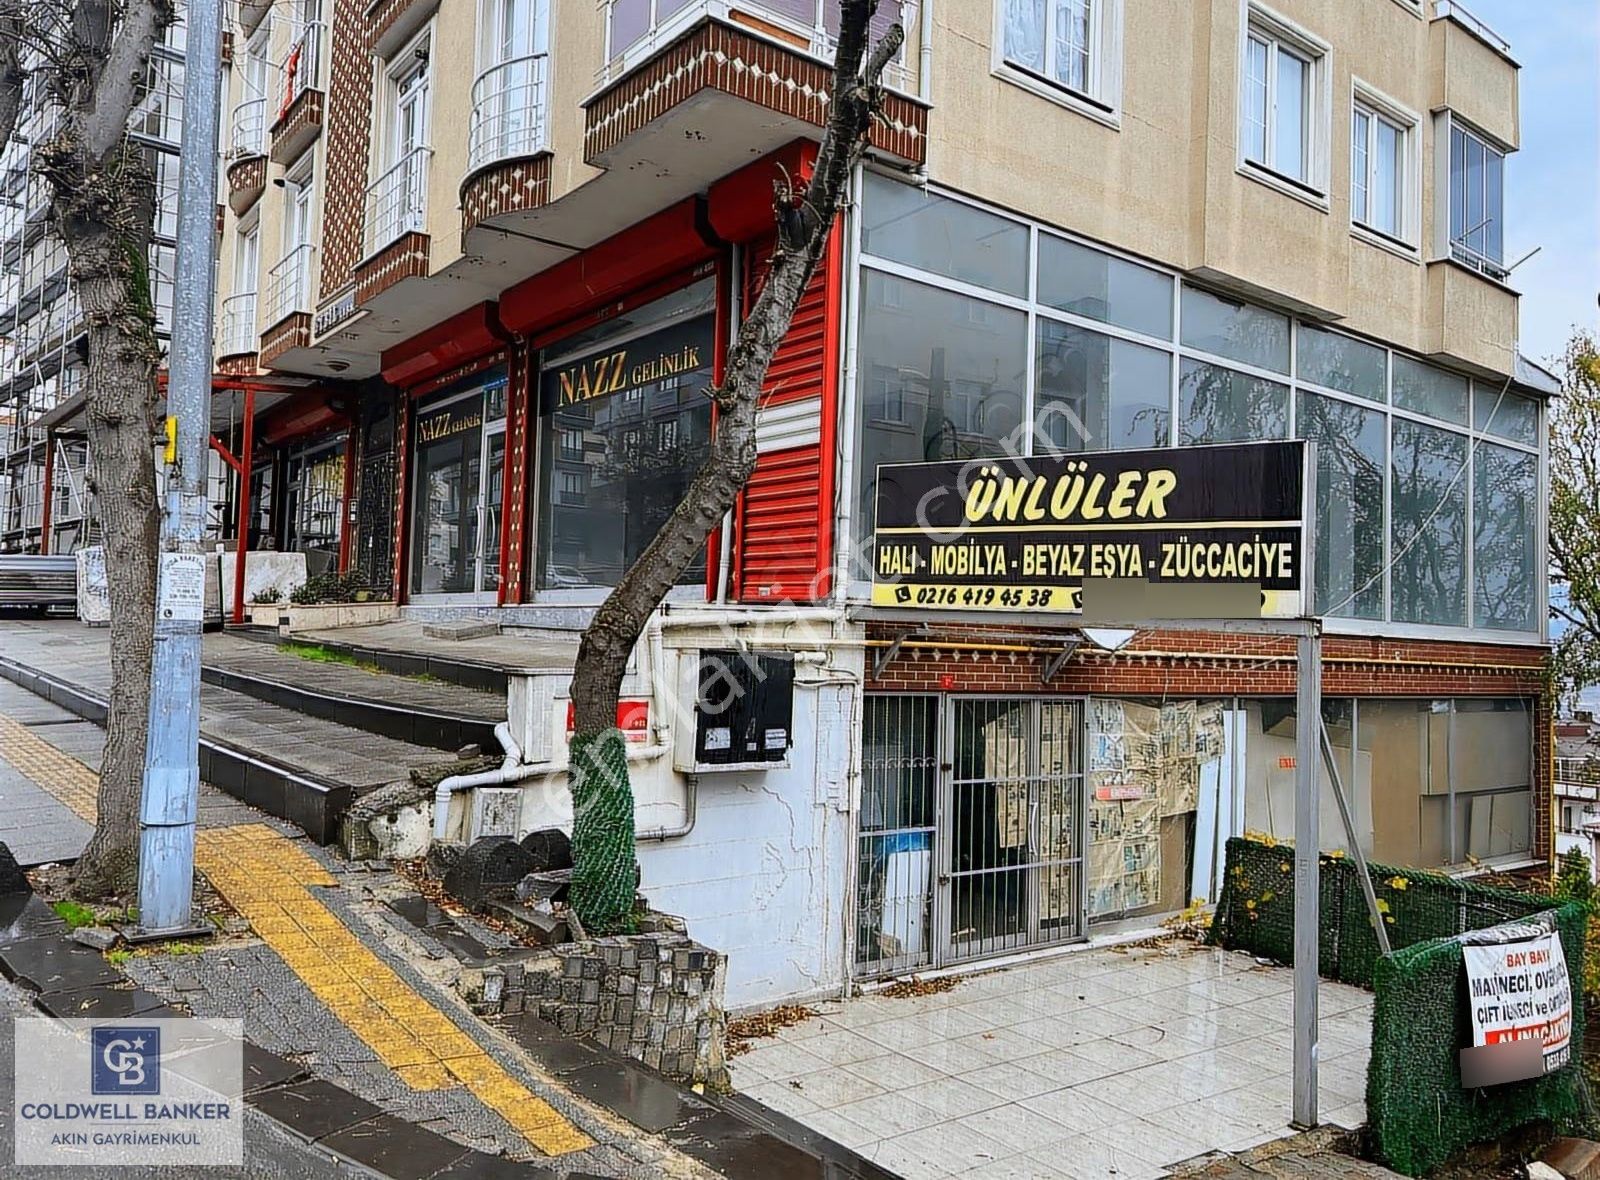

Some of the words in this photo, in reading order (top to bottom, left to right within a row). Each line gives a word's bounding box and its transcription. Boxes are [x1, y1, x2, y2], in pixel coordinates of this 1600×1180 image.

[558, 351, 627, 407] NAZZ
[632, 346, 700, 385] GELİNLİK
[419, 413, 451, 443] NAZZ
[964, 461, 1177, 522] ÜNLÜLER
[879, 544, 917, 575] HALI
[930, 538, 1007, 576] MOBİLYA
[1022, 545, 1086, 577] BEYAZ
[1090, 545, 1144, 579] EŞYA
[1161, 534, 1293, 578] ZÜCCACİYE
[916, 586, 957, 605] 0216
[962, 587, 995, 606] 419
[1000, 588, 1022, 606] 45
[1027, 589, 1053, 607] 38
[1506, 952, 1527, 968] BAY
[1477, 1003, 1500, 1028] ÇİFT
[1535, 1002, 1548, 1016] ve
